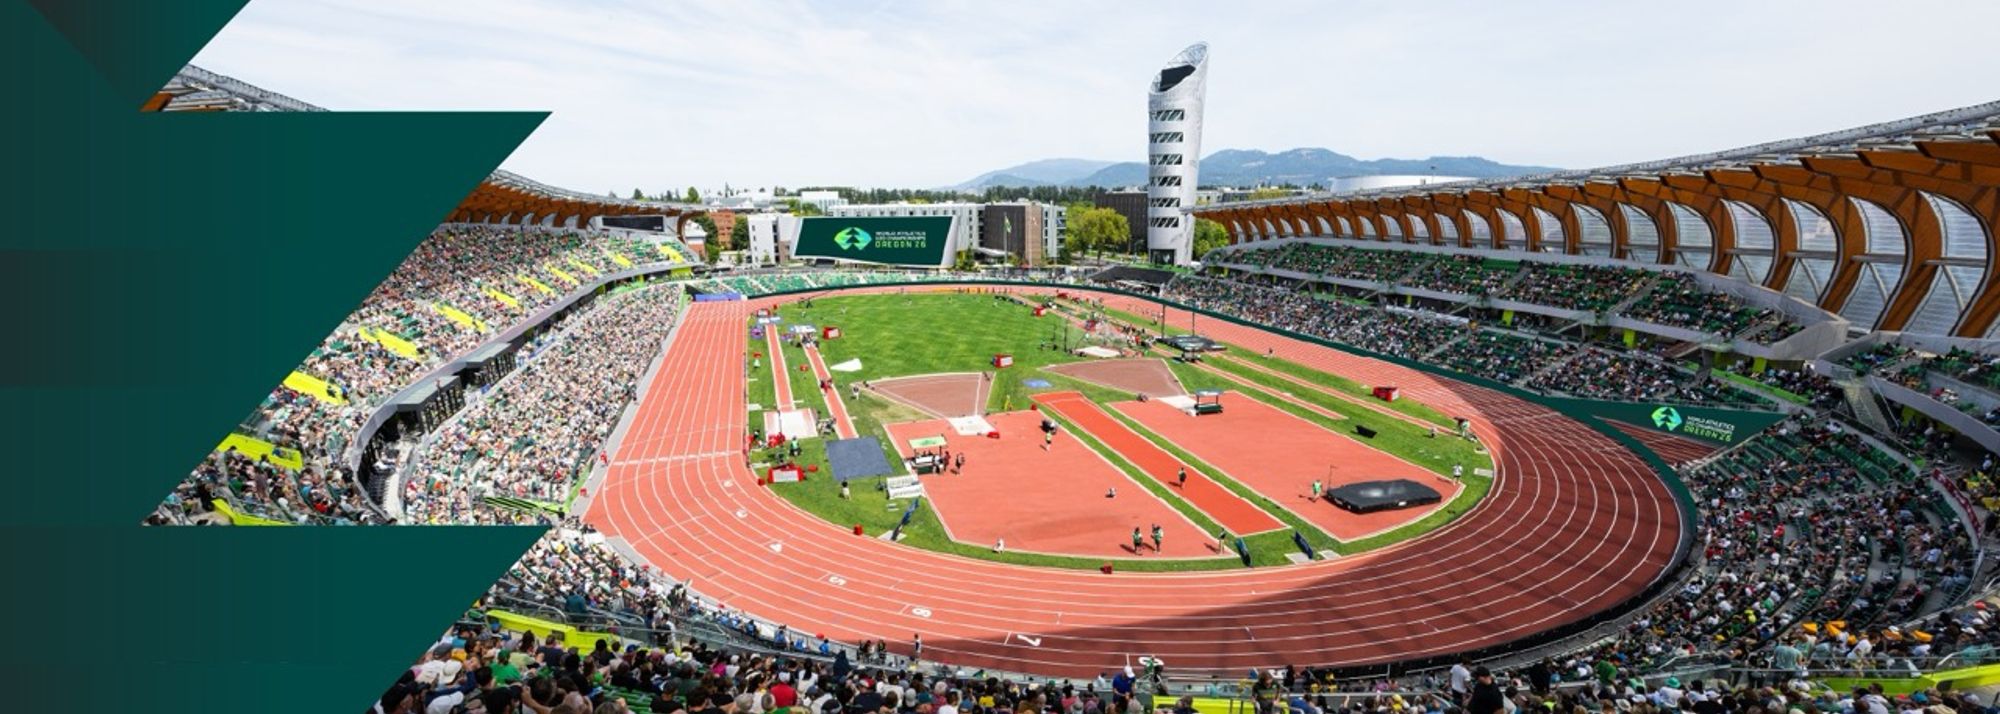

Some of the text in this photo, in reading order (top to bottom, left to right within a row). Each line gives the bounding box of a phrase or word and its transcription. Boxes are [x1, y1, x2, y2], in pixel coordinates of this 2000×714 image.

[875, 240, 926, 248] OREGON 26
[828, 574, 847, 586] 5
[1016, 633, 1042, 647] 7
